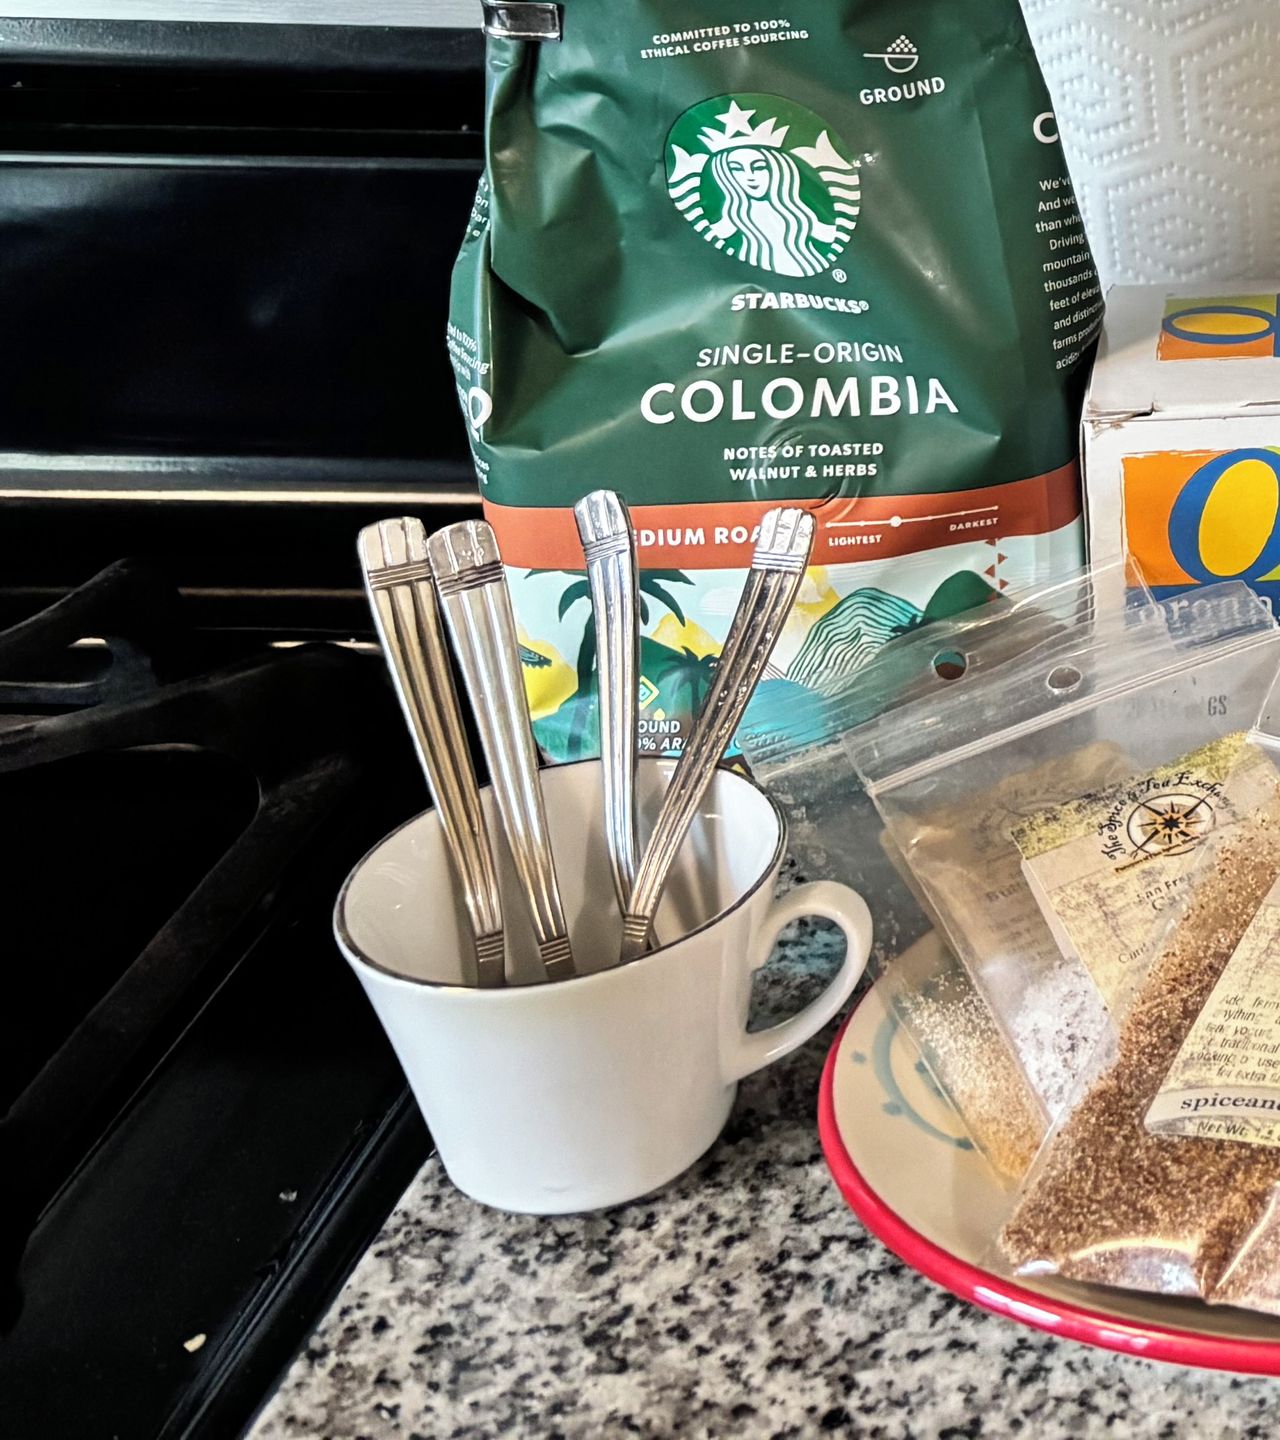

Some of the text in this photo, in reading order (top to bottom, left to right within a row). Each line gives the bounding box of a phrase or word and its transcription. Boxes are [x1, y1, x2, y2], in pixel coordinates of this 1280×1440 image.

[652, 18, 791, 45] COMMITTED TO 100%
[640, 29, 810, 59] ETHICAL COFFEE SOURCING
[859, 76, 946, 106] GROUND
[1037, 197, 1061, 213] And
[1035, 215, 1062, 234] than
[1050, 232, 1085, 251] Driving
[1043, 250, 1090, 273] mountain
[1043, 271, 1093, 293] thousands
[1049, 291, 1081, 311] feet of
[1053, 314, 1071, 330] and
[1052, 331, 1077, 351] farms
[696, 341, 904, 367] SINGLE-ORIGIN
[640, 375, 959, 424] COLOMBIA
[724, 442, 884, 461] NOTES OF TOASTED
[729, 463, 878, 481] WALNUT & HERBS
[949, 517, 999, 532] DARKEST
[634, 526, 760, 547] DIUM ROA
[828, 534, 882, 547] LIGHTEST
[637, 720, 681, 734] OUND
[1097, 798, 1128, 837] Spice
[1137, 776, 1171, 794] Tea
[1220, 1038, 1280, 1054] traditional
[1257, 1057, 1280, 1069] use
[1197, 1120, 1222, 1134] Net
